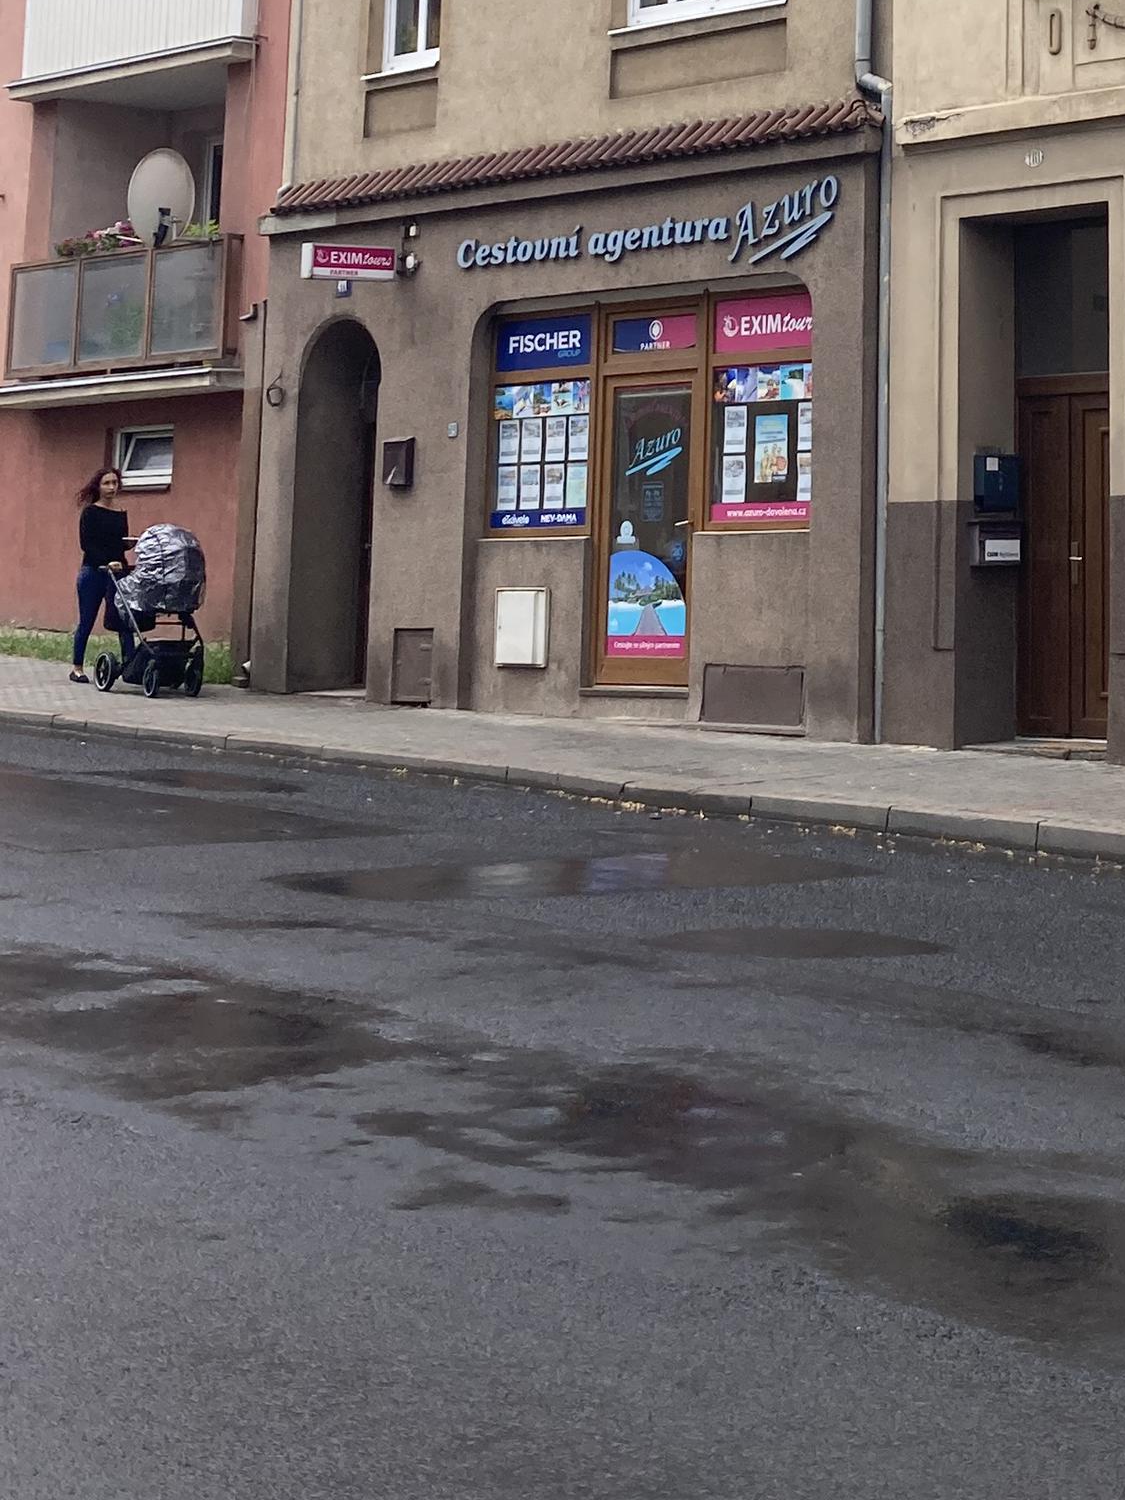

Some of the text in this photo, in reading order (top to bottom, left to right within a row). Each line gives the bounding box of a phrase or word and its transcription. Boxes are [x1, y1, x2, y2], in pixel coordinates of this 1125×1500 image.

[456, 174, 839, 269] Cestovní agentura Azuro
[330, 251, 392, 266] EXIMtours
[741, 312, 812, 336] EXIMtour
[508, 329, 581, 354] FISCHER
[640, 340, 670, 350] PARTNER
[629, 427, 681, 468] Azuro
